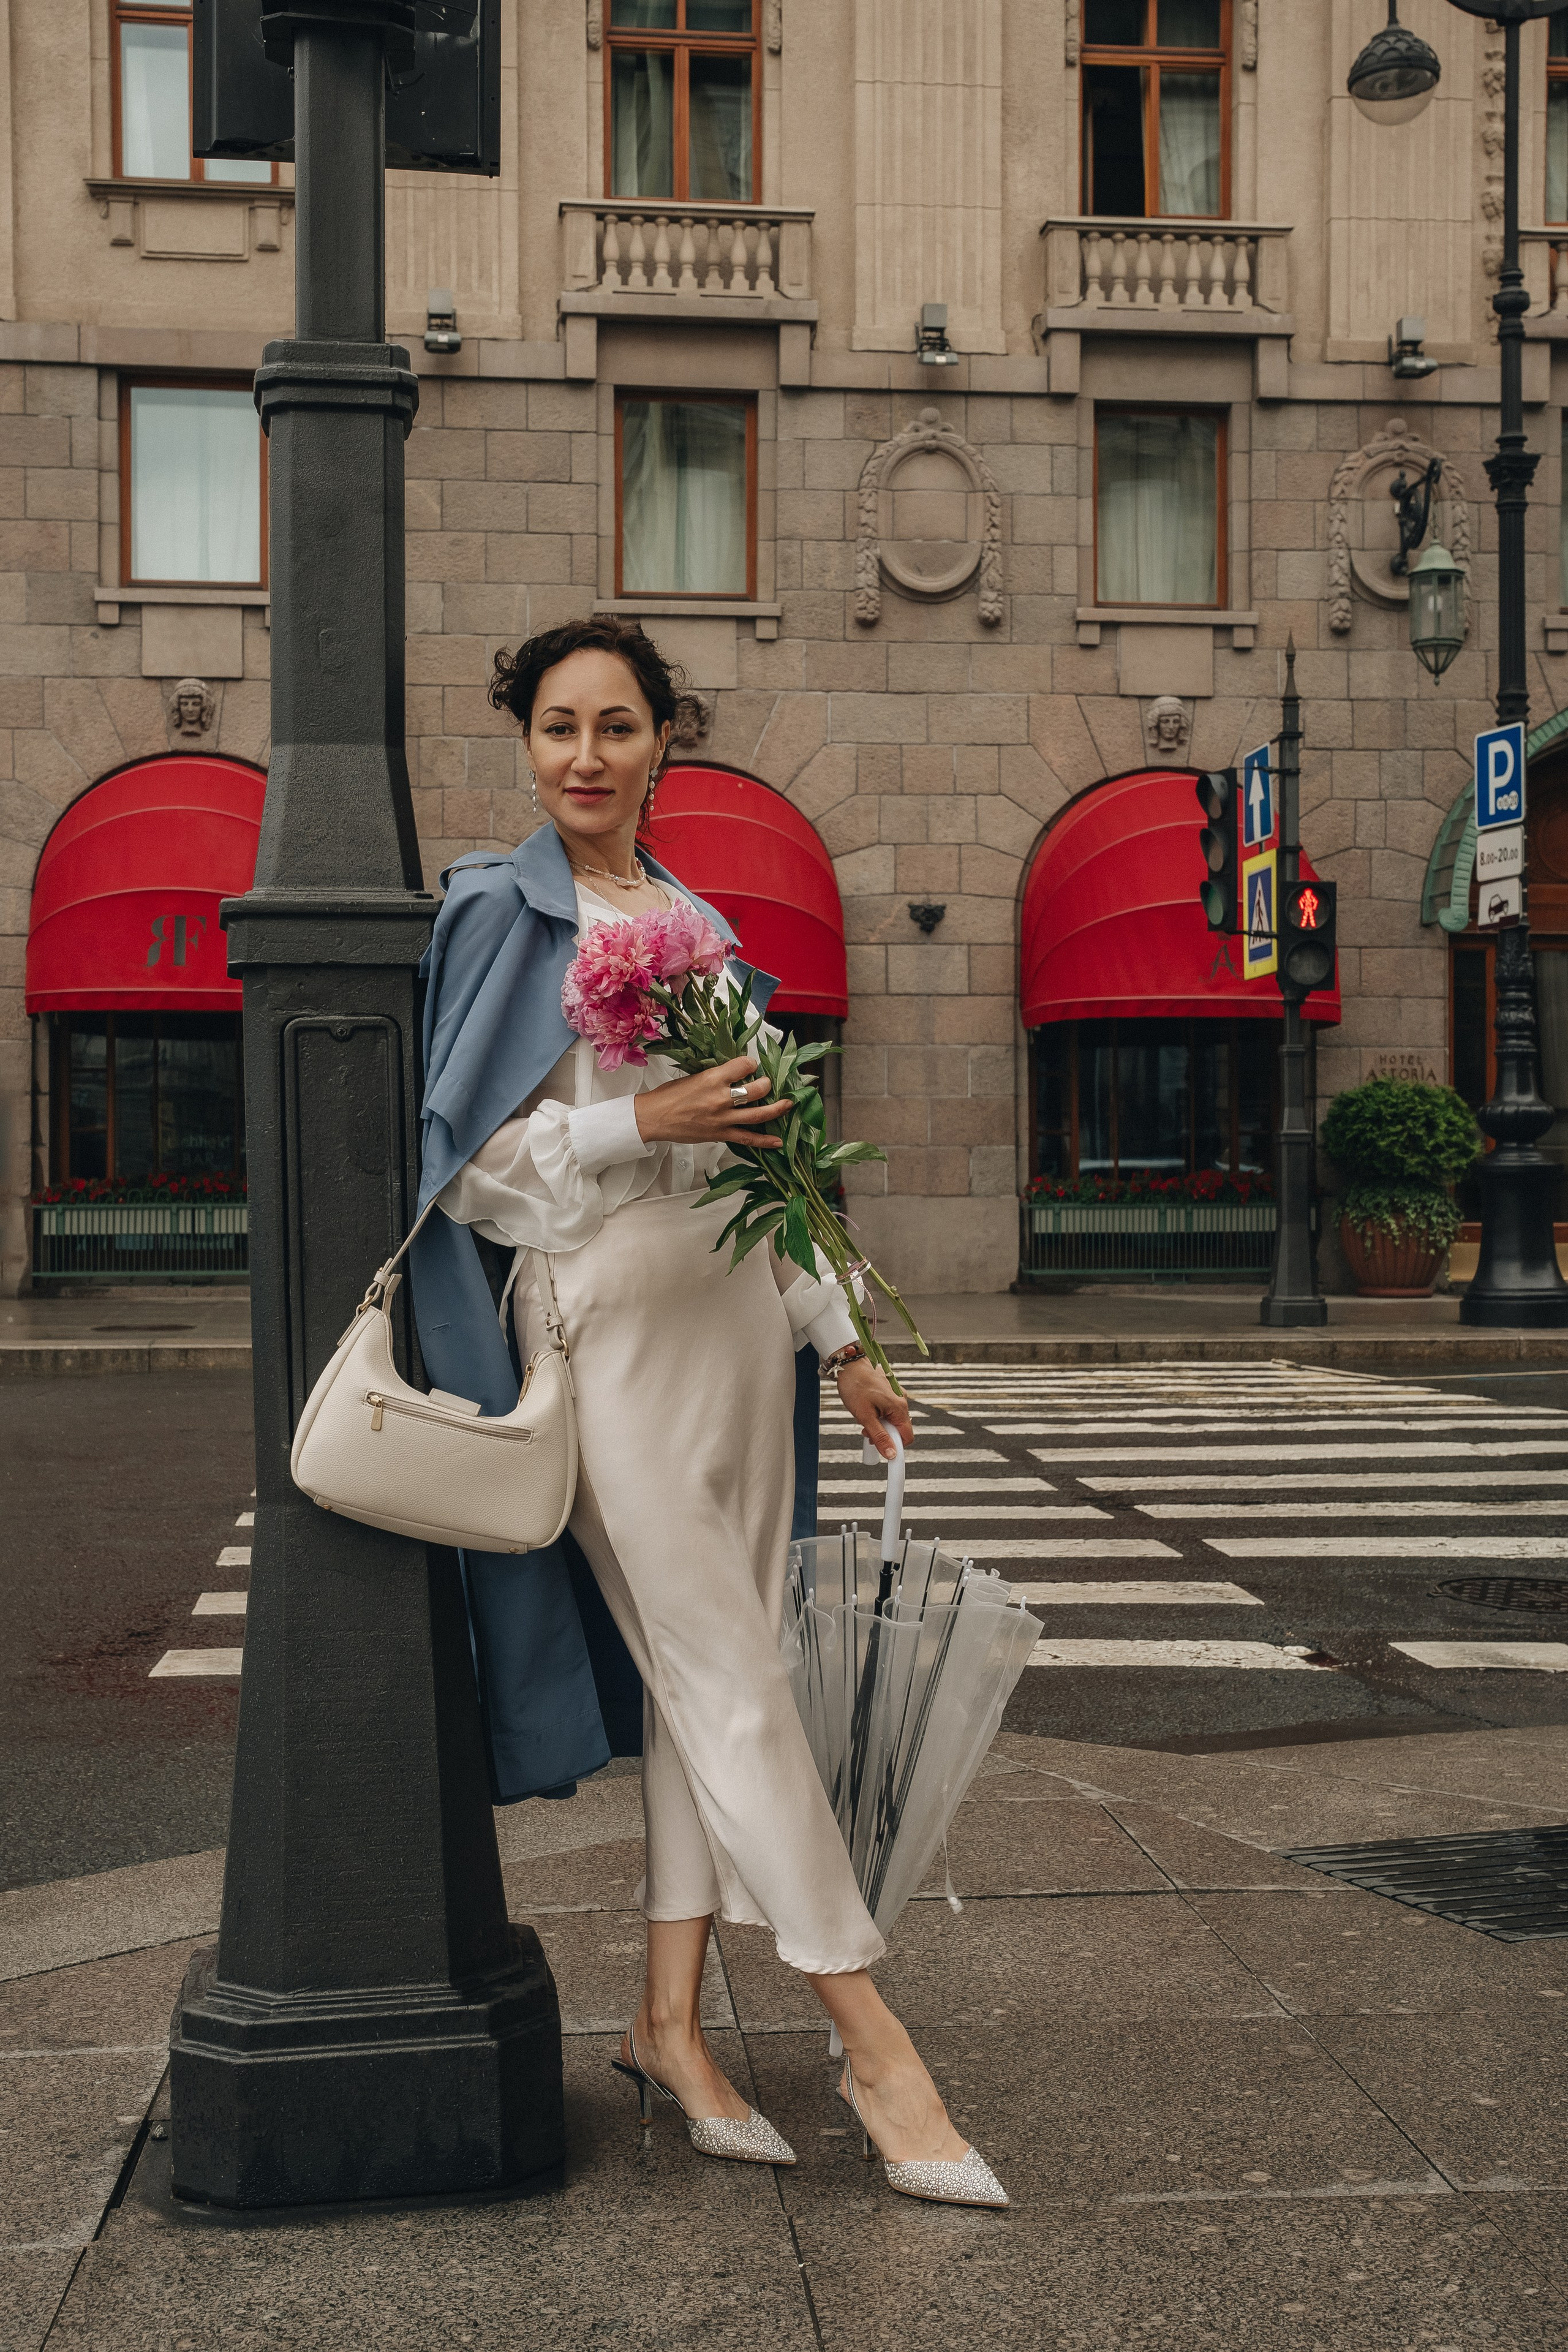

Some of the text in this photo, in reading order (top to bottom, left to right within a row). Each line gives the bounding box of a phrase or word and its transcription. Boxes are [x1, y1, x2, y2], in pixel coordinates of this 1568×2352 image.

[1488, 739, 1514, 815] P
[1480, 847, 1518, 866] 8.00-20.00
[1199, 944, 1243, 984] A
[1379, 1054, 1423, 1066] HOTEL
